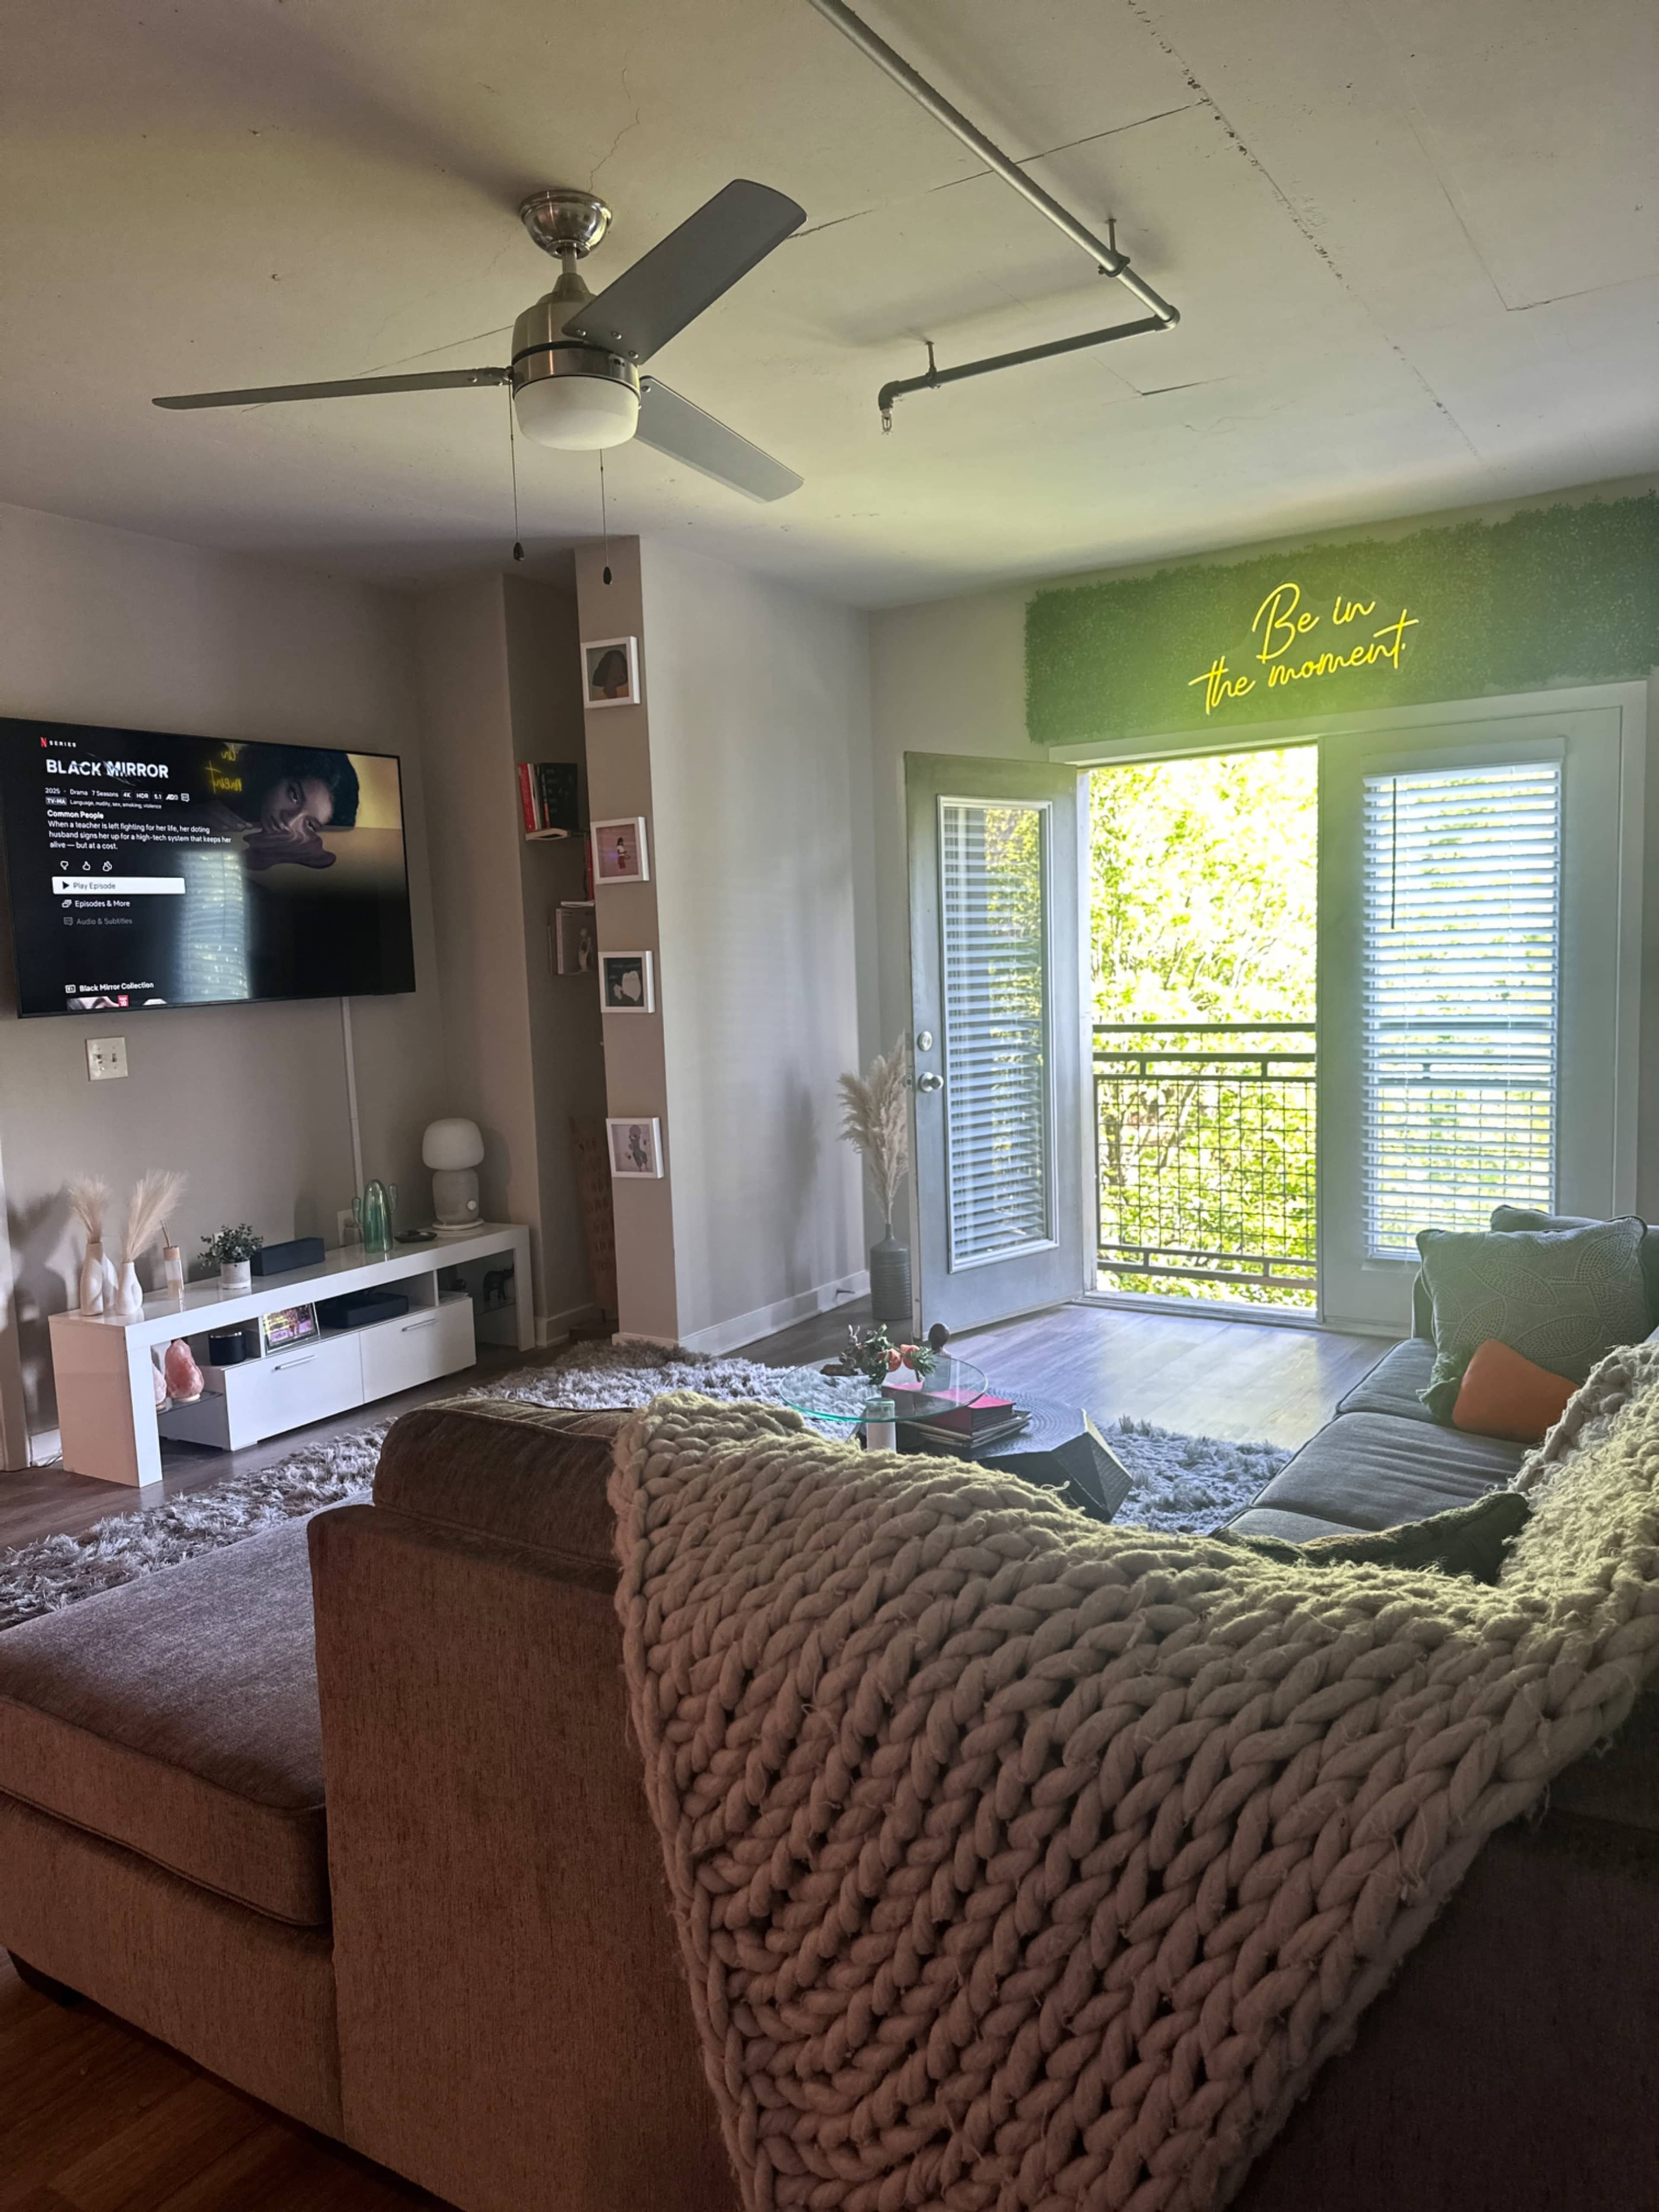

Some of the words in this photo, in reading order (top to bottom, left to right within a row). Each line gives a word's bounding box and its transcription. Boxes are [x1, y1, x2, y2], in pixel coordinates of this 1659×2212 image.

[1252, 582, 1319, 664] Be
[1332, 596, 1375, 625] in
[1188, 655, 1255, 715] the
[46, 759, 102, 776] BLACK
[106, 760, 169, 778] MIRROR
[47, 809, 79, 818] Common
[80, 811, 104, 820] People
[121, 823, 145, 832] fighting
[167, 825, 179, 833] life,
[191, 826, 210, 834] doting
[79, 832, 98, 840] signs
[136, 833, 167, 842] high-tech
[73, 882, 88, 890] Play
[75, 900, 105, 909] Episodes
[121, 981, 154, 990] Collection
